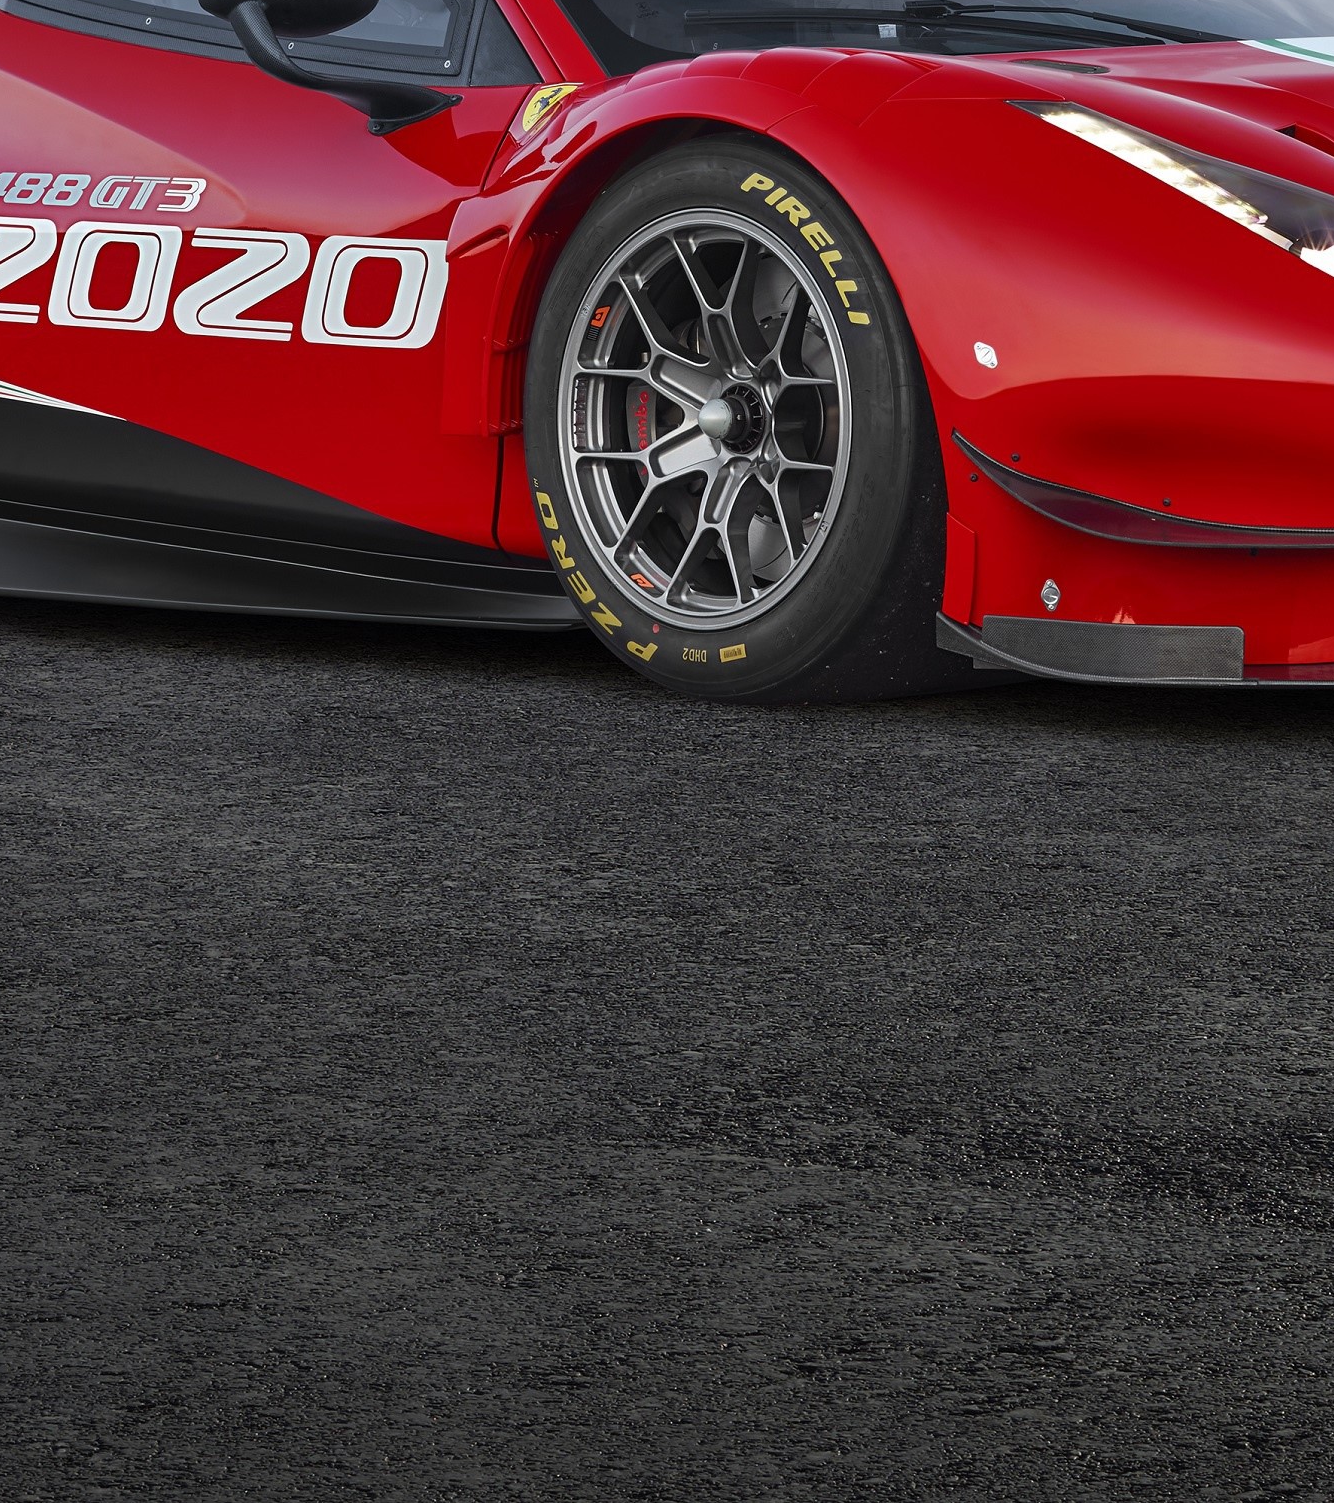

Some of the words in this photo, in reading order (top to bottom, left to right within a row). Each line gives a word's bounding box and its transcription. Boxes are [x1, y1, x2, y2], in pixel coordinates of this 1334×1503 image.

[89, 175, 207, 213] GT3
[740, 172, 871, 325] PIRELLI
[536, 491, 623, 635] ZERO
[626, 640, 659, 662] P
[682, 647, 707, 663] DHD2
